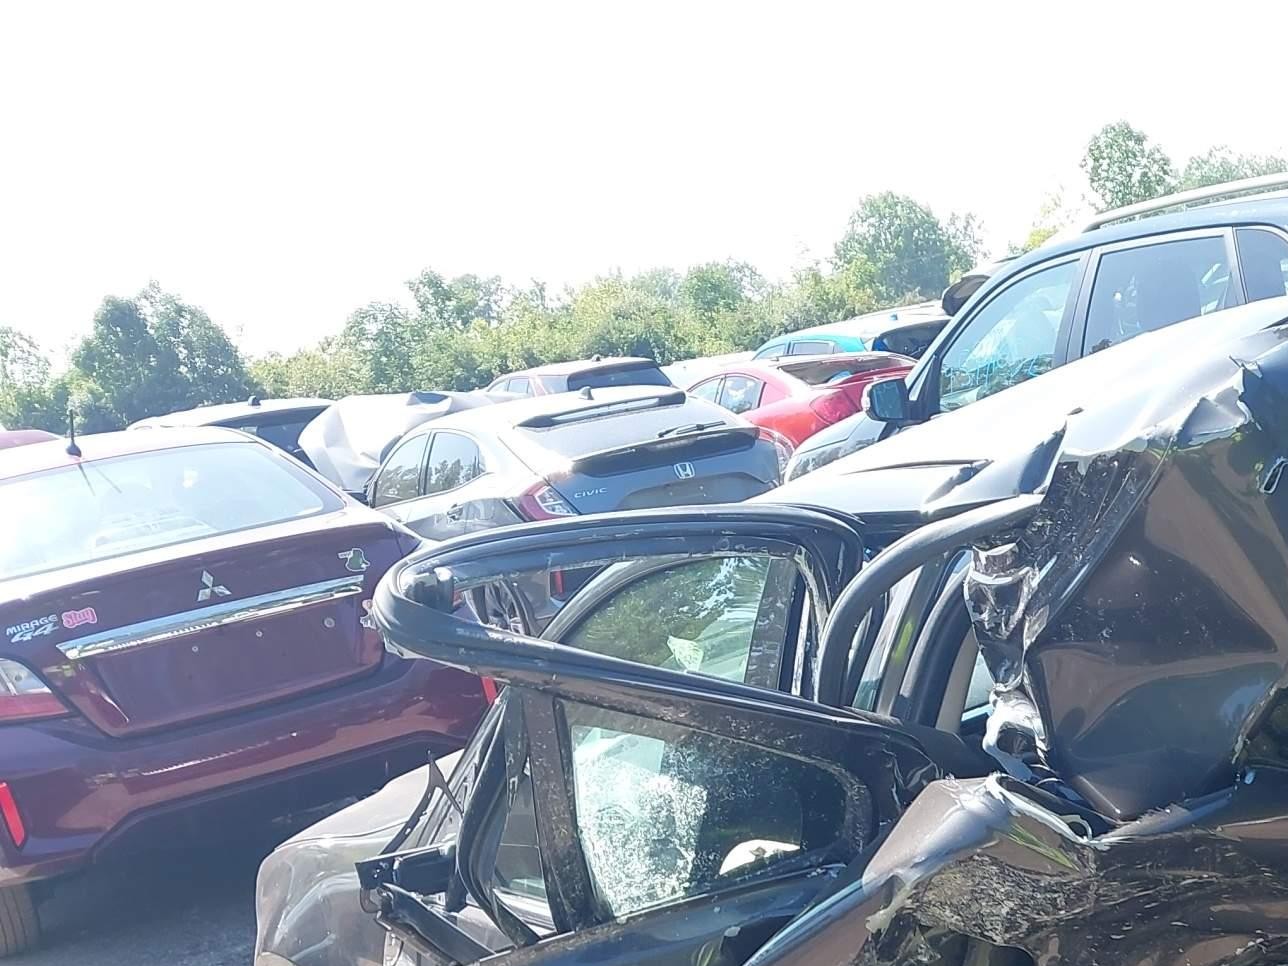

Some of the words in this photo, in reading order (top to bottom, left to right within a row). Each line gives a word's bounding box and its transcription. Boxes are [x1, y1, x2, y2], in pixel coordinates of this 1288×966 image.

[574, 487, 608, 499] CIVIC
[6, 614, 58, 636] MIRAGE
[11, 623, 59, 643] G4
